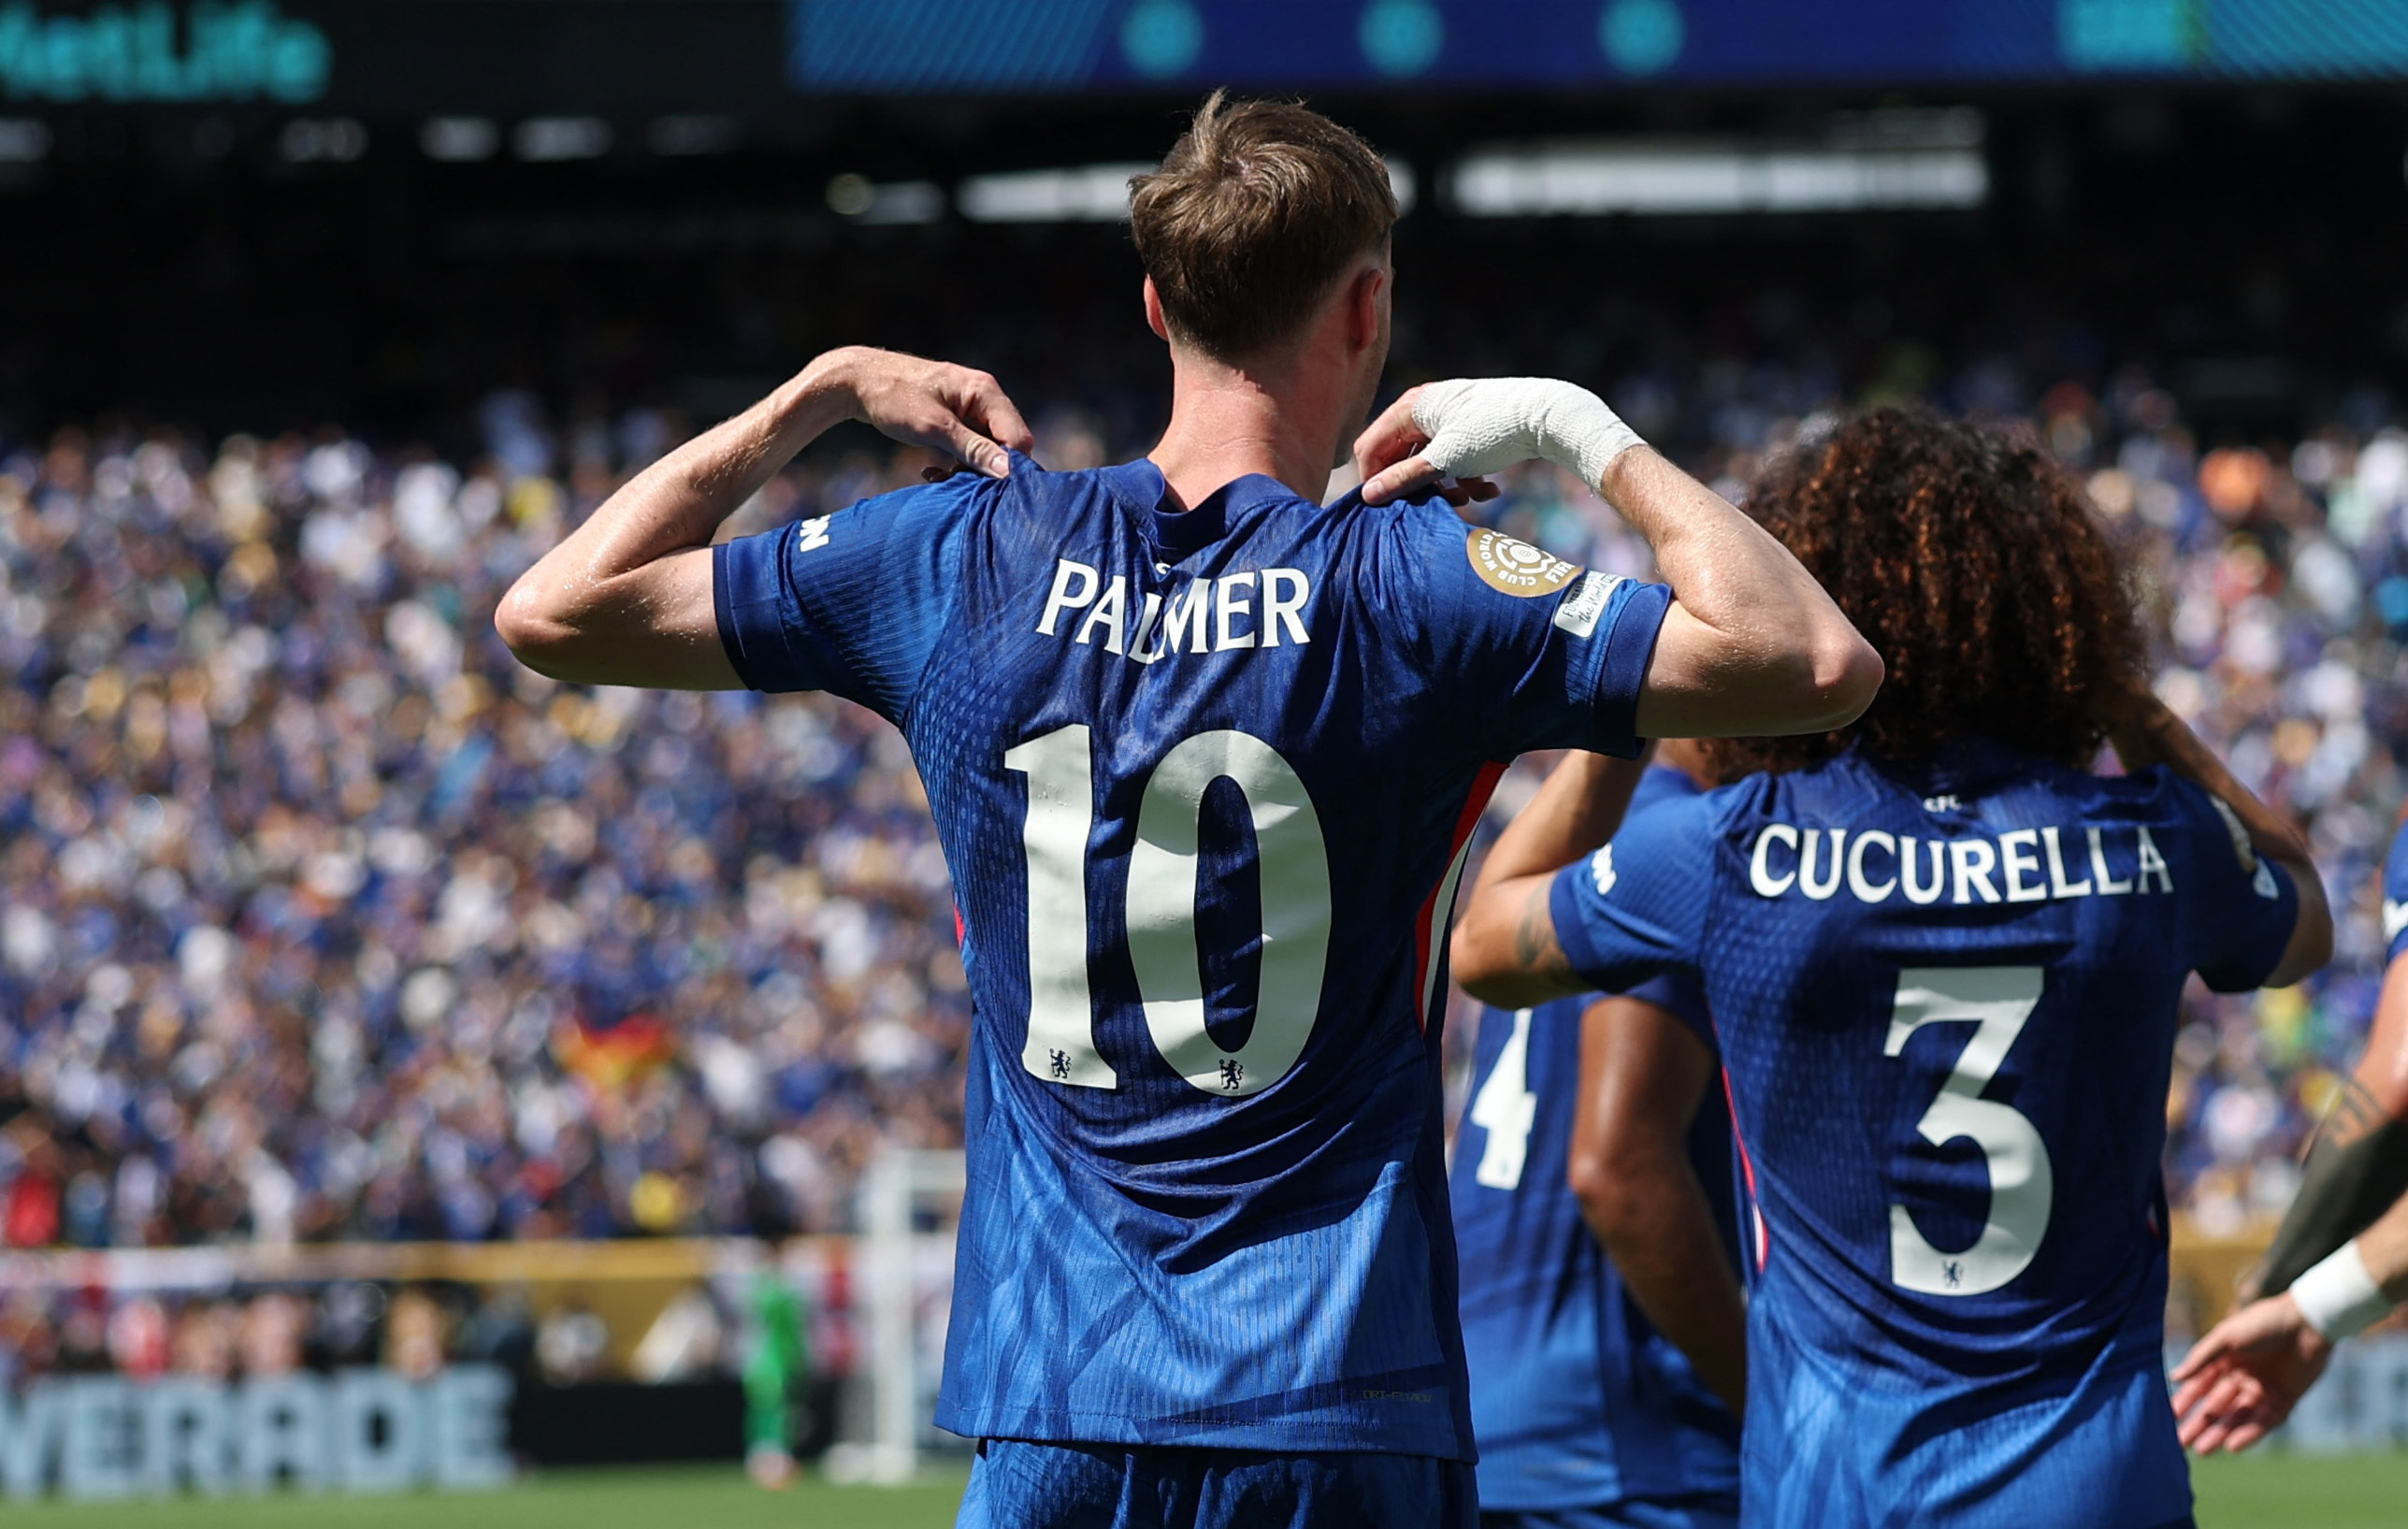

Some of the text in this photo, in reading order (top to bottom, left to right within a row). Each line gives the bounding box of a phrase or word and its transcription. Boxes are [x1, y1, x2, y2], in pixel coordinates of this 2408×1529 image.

[1479, 533, 1498, 571] WORLD
[1497, 570, 1536, 586] CLUB
[1544, 561, 1576, 584] FIFA
[1035, 558, 1310, 665] PALMER
[1004, 723, 1332, 1098] 10
[1750, 823, 2174, 905] CUCURELLA
[1471, 1007, 1536, 1190] 4
[1883, 966, 2054, 1296] 3
